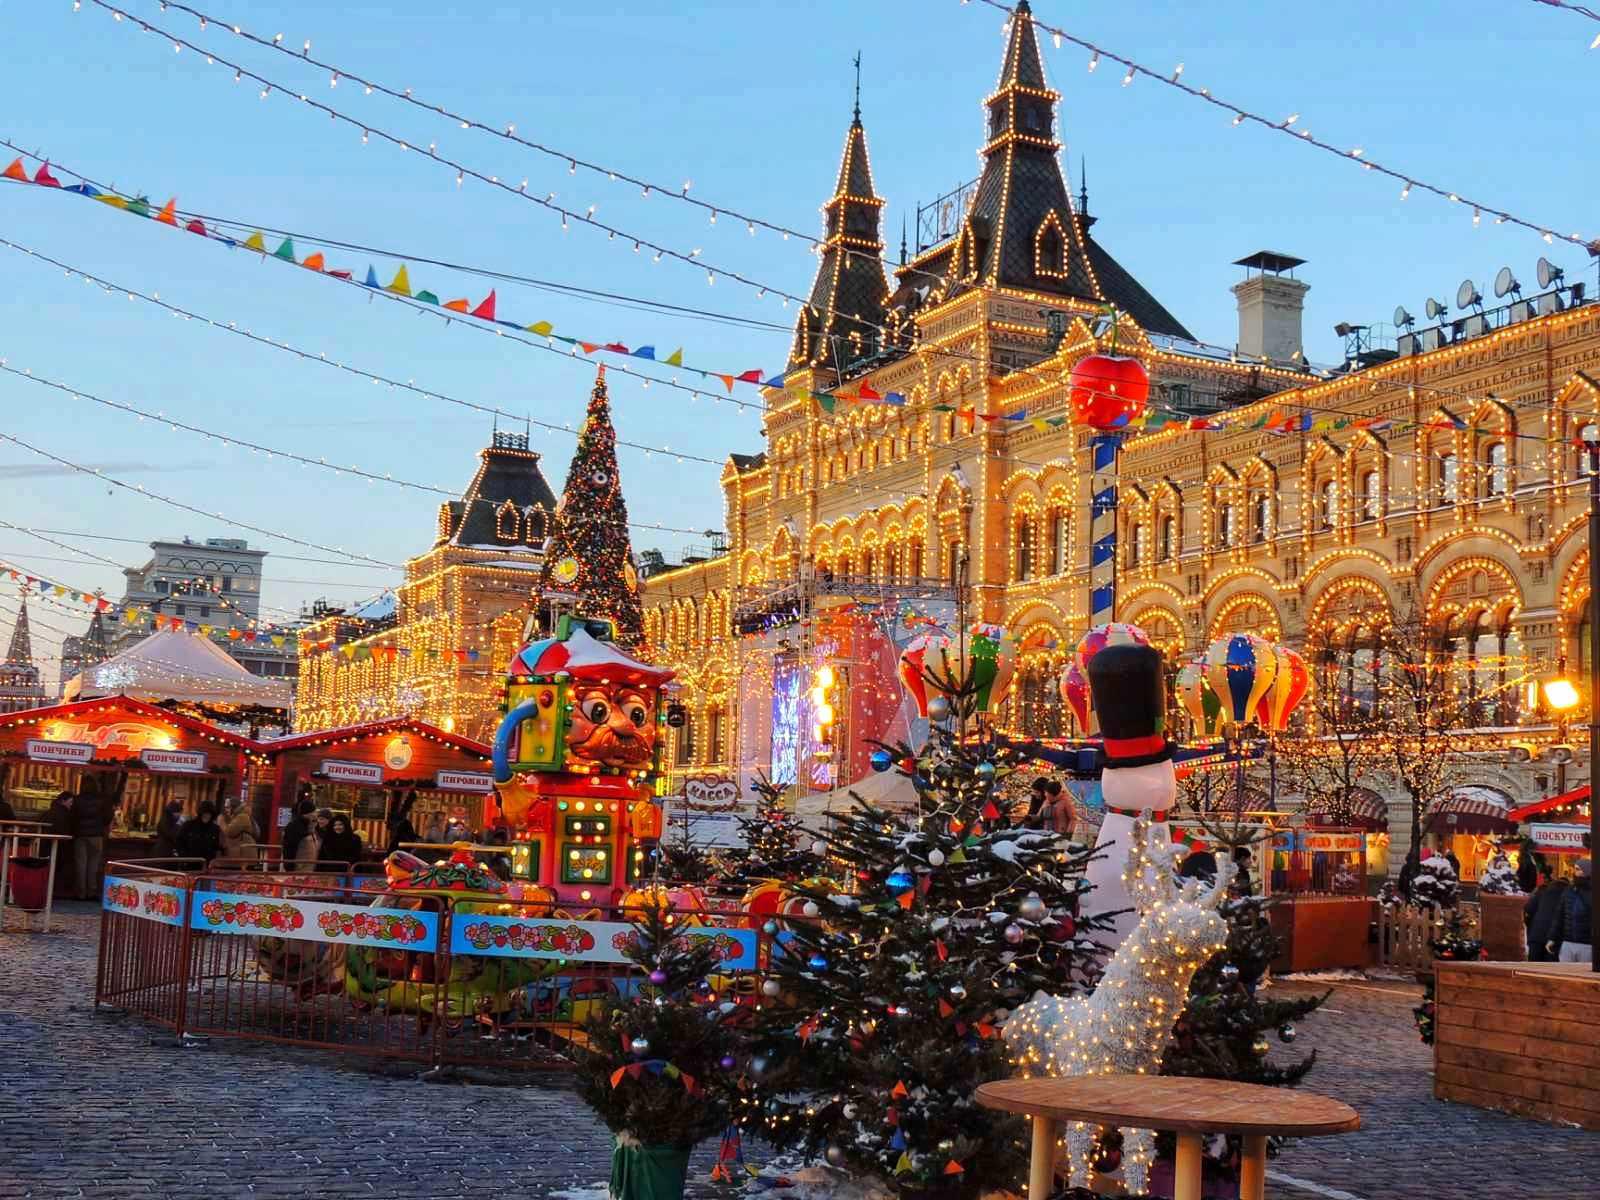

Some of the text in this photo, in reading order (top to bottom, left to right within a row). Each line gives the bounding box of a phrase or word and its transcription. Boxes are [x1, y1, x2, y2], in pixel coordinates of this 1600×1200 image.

[33, 745, 85, 757] ПОНЧИКИ
[147, 754, 198, 765] ПОНЧИКИ
[328, 765, 376, 777] ПИРОЖКИ
[442, 775, 489, 786] ПИРОЖКИ
[688, 785, 734, 801] КАССА
